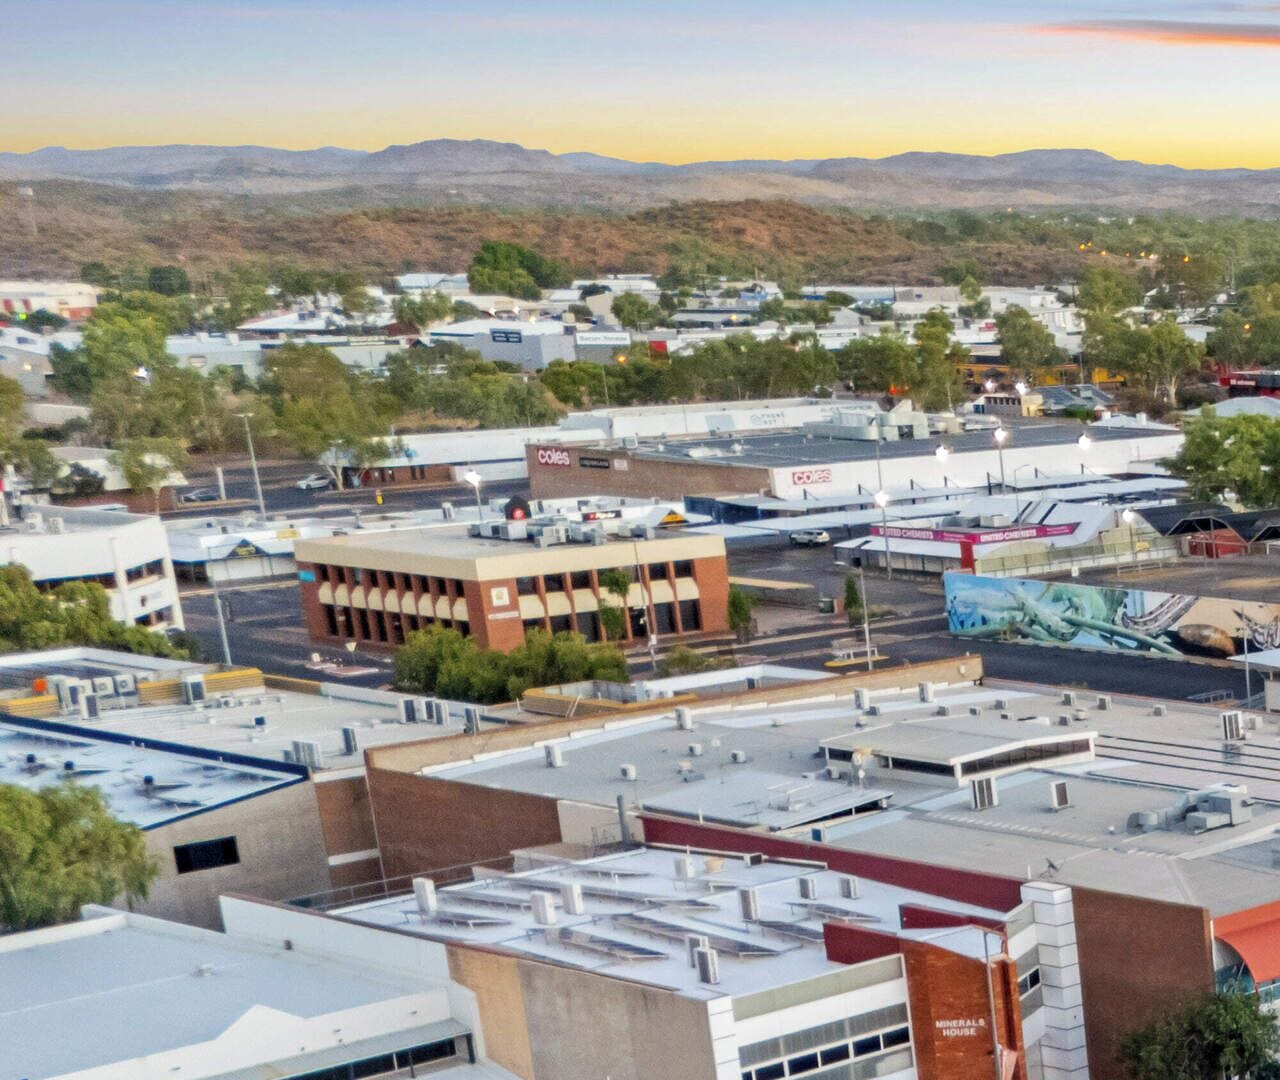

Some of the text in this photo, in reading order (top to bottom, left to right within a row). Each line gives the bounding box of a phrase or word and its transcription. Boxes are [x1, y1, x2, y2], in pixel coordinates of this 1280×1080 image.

[538, 449, 570, 465] coles
[935, 1018, 985, 1028] MINERALS
[942, 1027, 977, 1037] HOUSE
